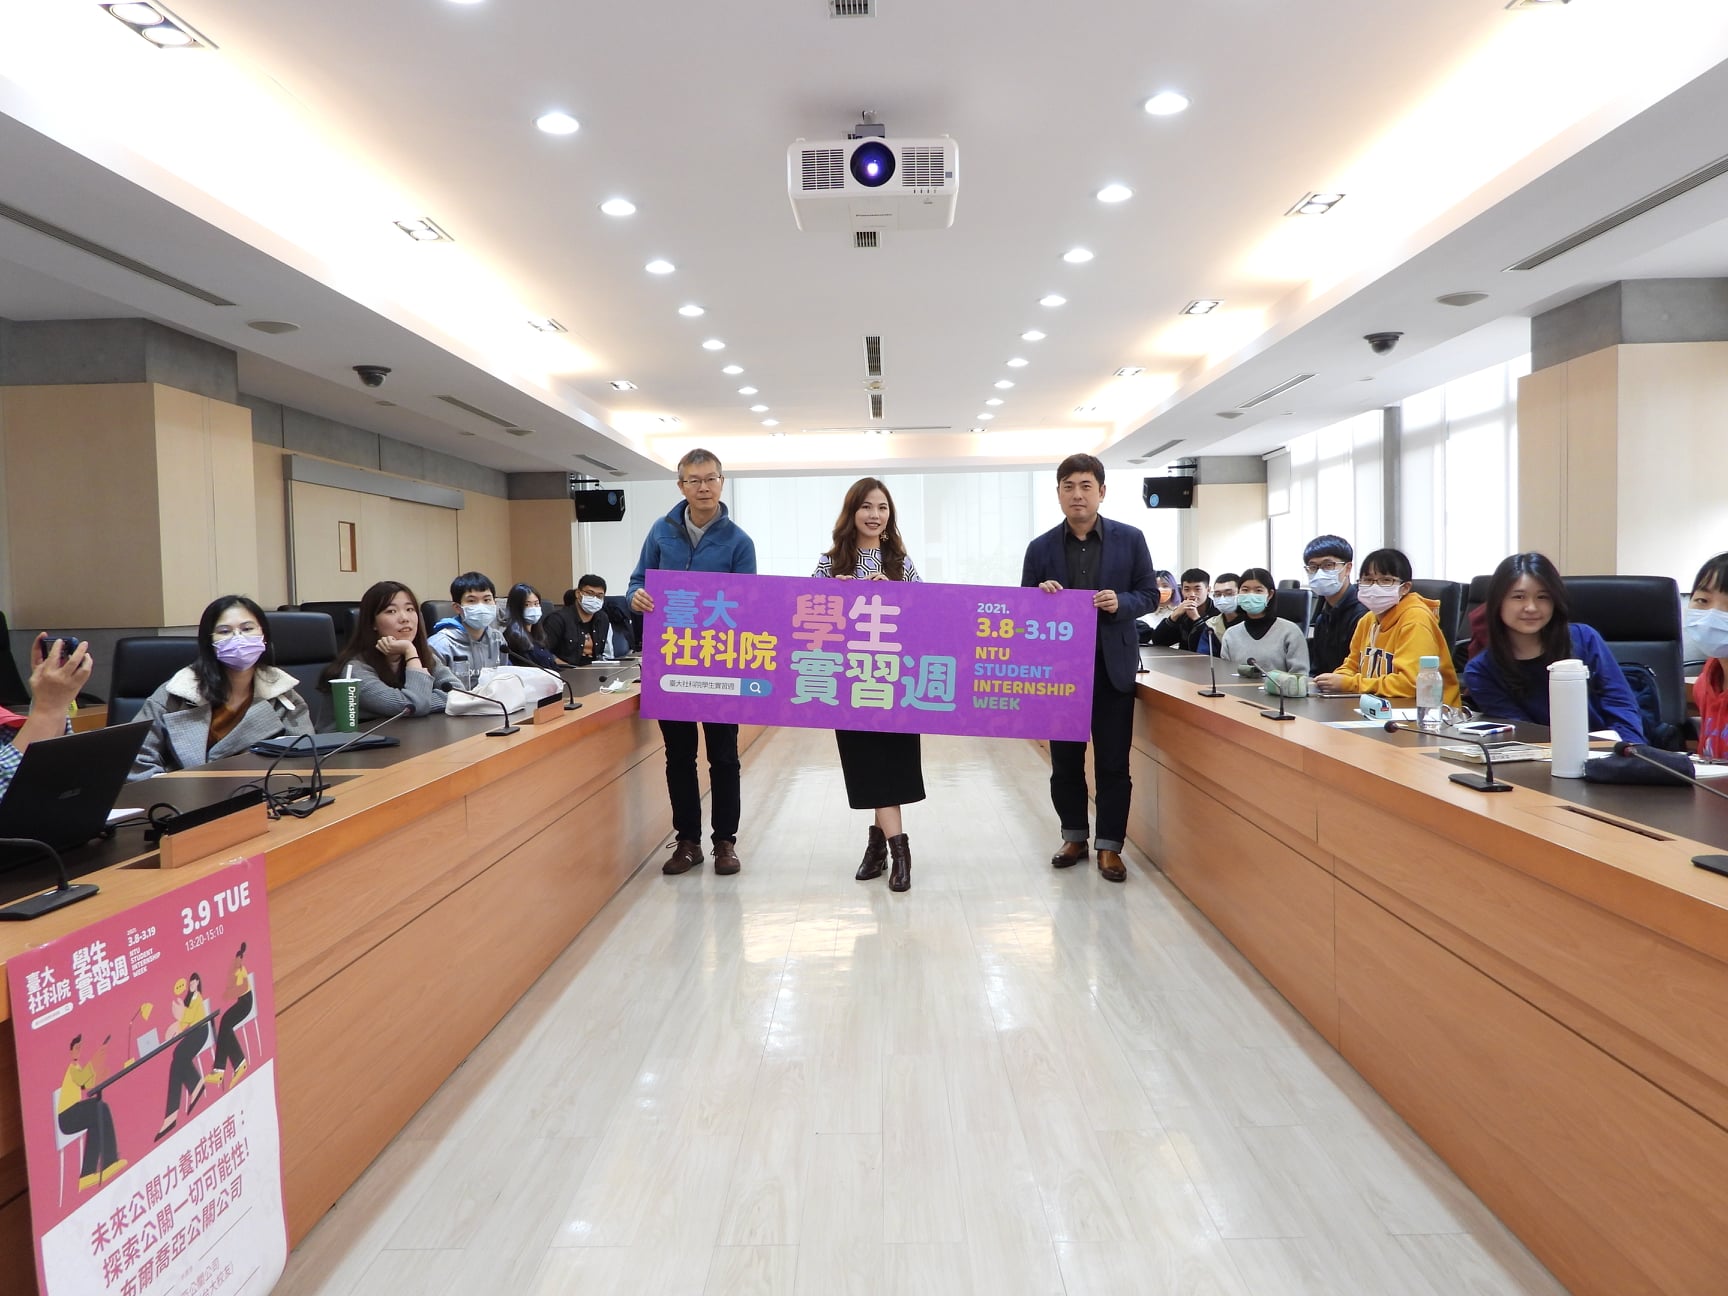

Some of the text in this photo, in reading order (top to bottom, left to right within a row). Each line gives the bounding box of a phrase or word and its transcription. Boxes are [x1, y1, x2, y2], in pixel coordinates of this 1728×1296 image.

[663, 589, 739, 628] 臺大
[977, 603, 1010, 614] 2021.
[792, 594, 902, 653] 學生
[976, 617, 1074, 641] 3.8-3.19
[660, 627, 778, 671] 社科院
[975, 646, 1010, 660] NTU
[790, 649, 957, 712] 實習週
[974, 663, 1053, 678] STUDENT
[973, 679, 1076, 696] INTERNSHIP
[973, 696, 1020, 710] WEEK
[181, 881, 251, 935] 3.9 TUE
[127, 926, 156, 947] 3.8-3.19
[185, 924, 224, 952] 13:20-15:10
[72, 939, 107, 978] 學生
[130, 948, 153, 964] STUDENT
[25, 965, 56, 995] 臺大
[74, 954, 130, 1005] 實習週
[28, 978, 72, 1014] 社科院
